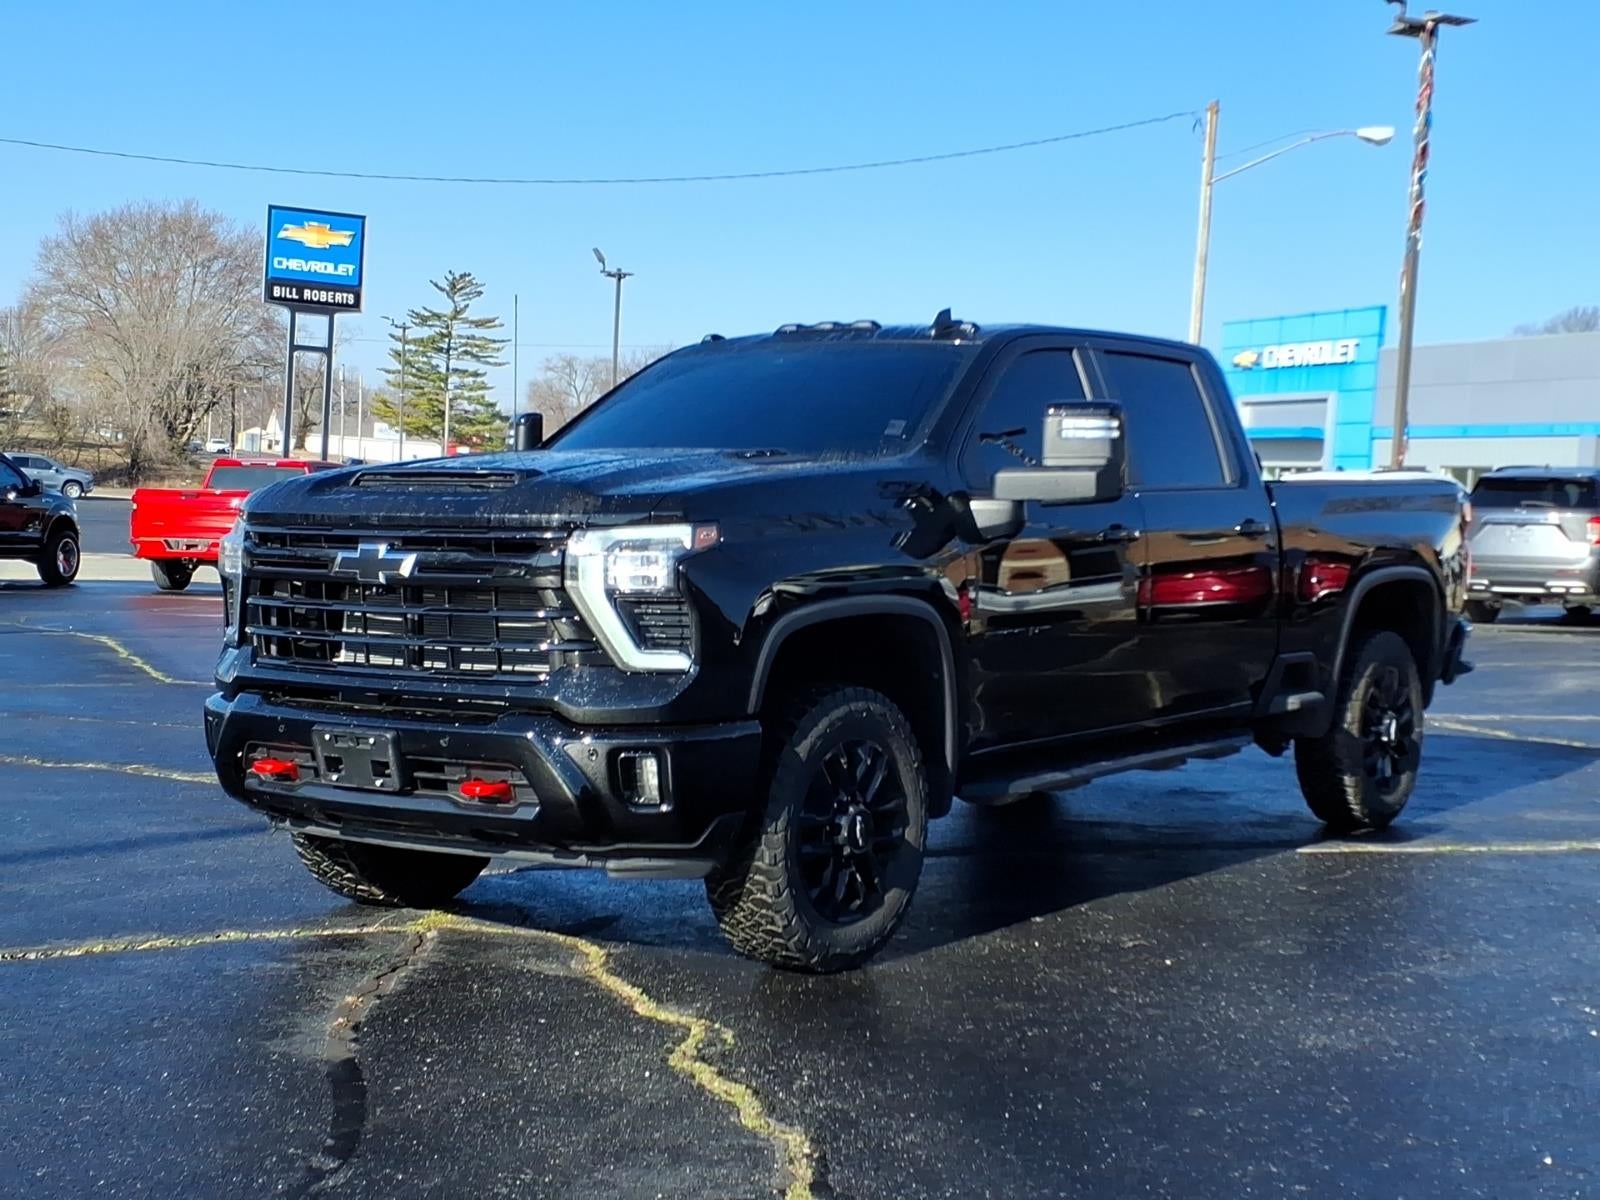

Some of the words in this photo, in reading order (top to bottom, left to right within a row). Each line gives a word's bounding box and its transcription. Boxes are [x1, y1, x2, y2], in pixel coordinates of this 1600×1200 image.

[273, 257, 355, 276] CHEVROLET
[273, 286, 299, 299] BILL
[303, 289, 355, 305] ROBERTS
[1262, 338, 1360, 369] CHEVROLET
